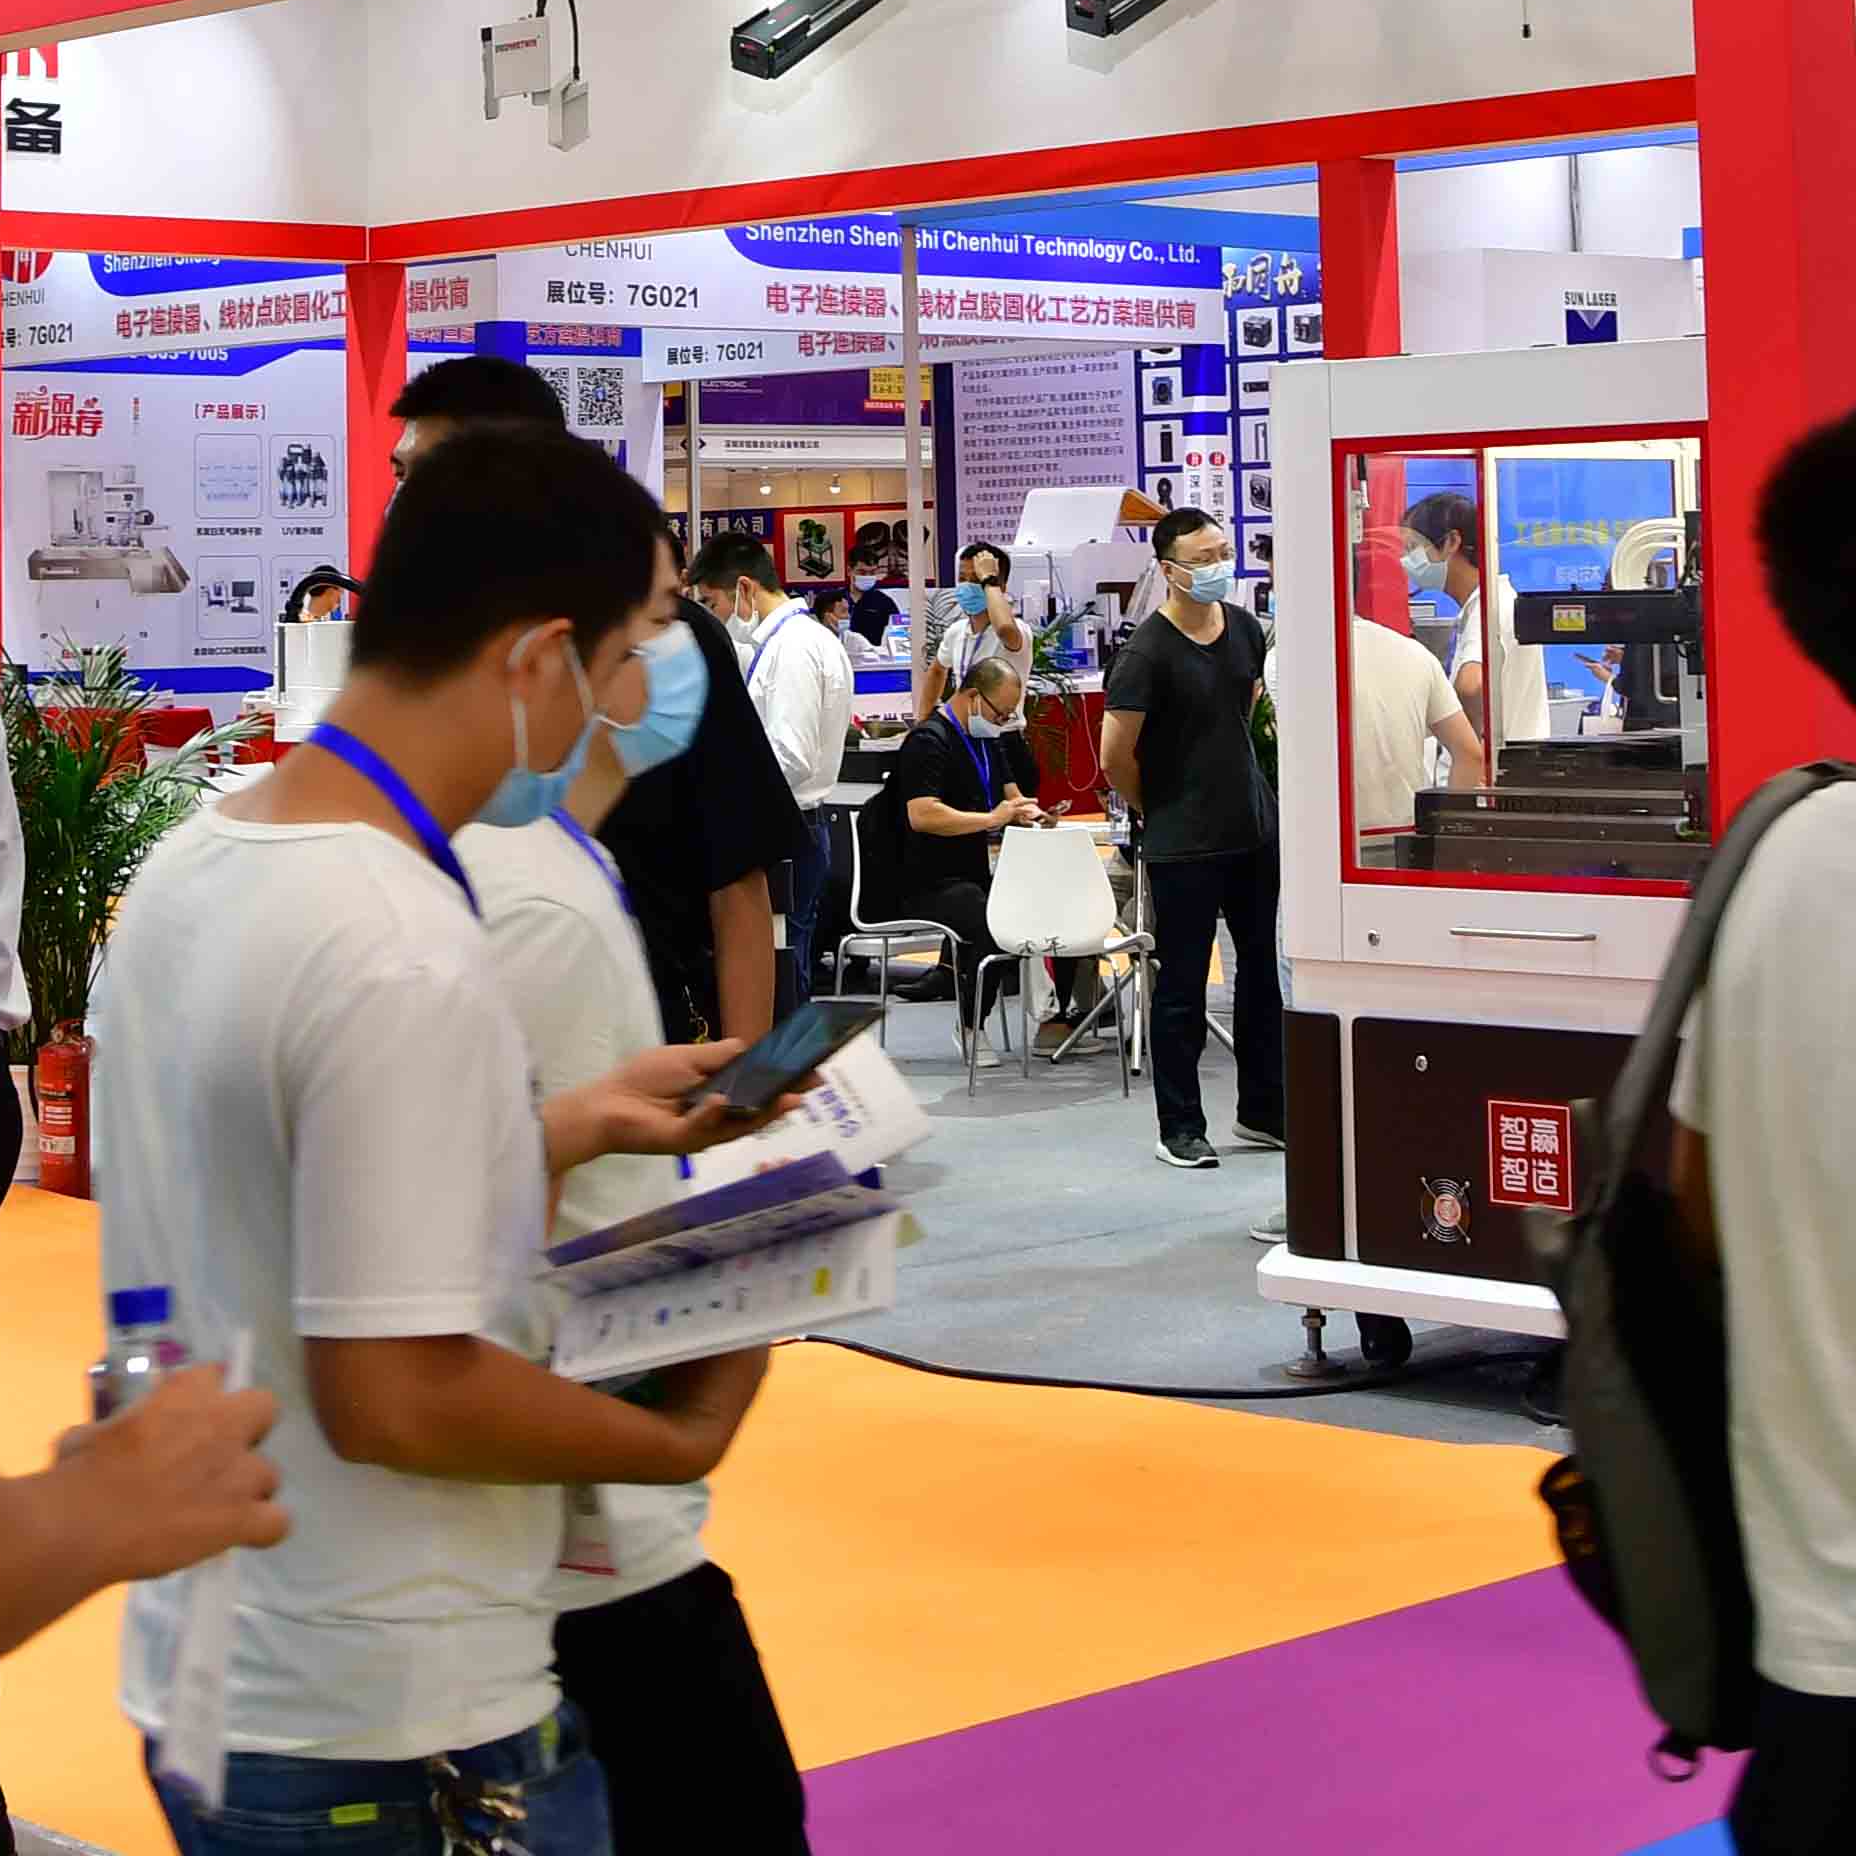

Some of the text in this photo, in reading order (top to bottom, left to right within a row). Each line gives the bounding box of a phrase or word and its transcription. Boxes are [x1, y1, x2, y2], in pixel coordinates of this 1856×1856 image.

[565, 239, 653, 262] CHENHUI
[745, 224, 1201, 265] Shenzhen Shenshi Chenhui Technology Co., Ltd.
[1, 288, 45, 307] HENHUI
[1564, 291, 1617, 306] SUN LASER
[1, 323, 73, 349] 号：7G021
